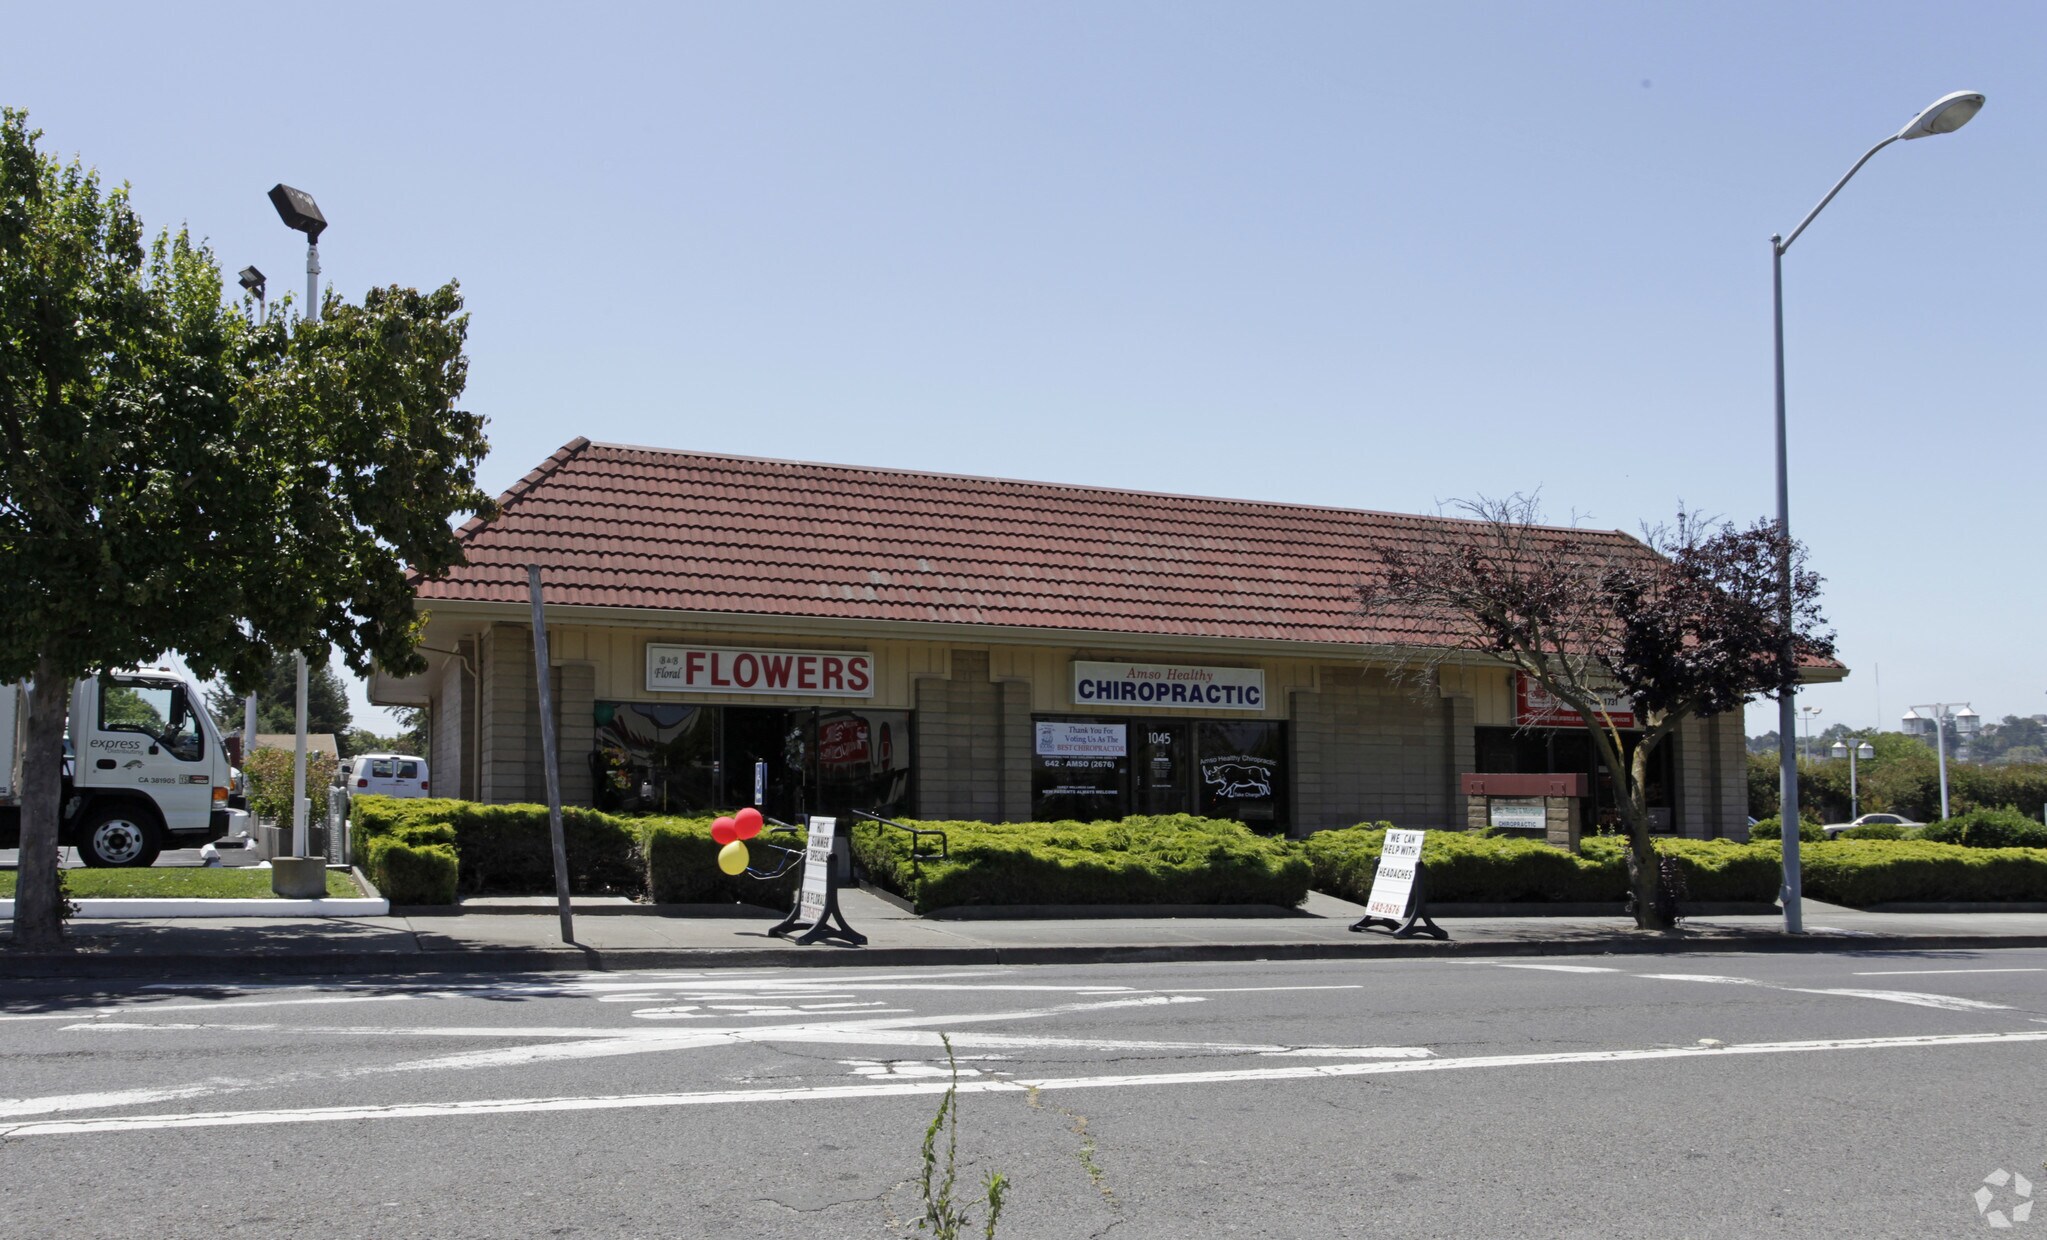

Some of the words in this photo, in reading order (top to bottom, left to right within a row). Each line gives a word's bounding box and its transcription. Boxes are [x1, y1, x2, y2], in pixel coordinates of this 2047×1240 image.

[653, 665, 683, 680] Floral
[685, 651, 870, 692] FLOWERS
[1125, 667, 1161, 681] Amso
[1166, 668, 1214, 683] Healthy
[1078, 678, 1261, 706] CHIROPRACTIC
[1068, 725, 1088, 735] Thank
[1090, 726, 1102, 735] You
[1103, 726, 1114, 735] For
[1065, 734, 1087, 745] Voting
[1087, 735, 1098, 743] Us
[1099, 736, 1107, 744] As
[1107, 736, 1119, 744] The
[1148, 731, 1171, 745] 1045
[90, 738, 140, 752] express
[1056, 744, 1073, 752] BEST
[1073, 744, 1126, 753] CHIROPRACTOR
[1044, 760, 1060, 768] 642
[1065, 760, 1089, 769] AMSO
[1090, 760, 1115, 770] (2676)
[1218, 754, 1241, 762] Healthy
[1241, 754, 1278, 767] Chiropractic
[138, 776, 149, 784] CA
[150, 777, 176, 785] 381905
[817, 822, 826, 834] HOT
[1498, 820, 1537, 829] CHIROPRACTIC
[812, 836, 829, 848] SUMMER
[1391, 834, 1401, 843] WE
[1404, 834, 1416, 844] CAN
[1384, 845, 1400, 854] HELP
[1401, 847, 1417, 856] WITH
[1379, 868, 1412, 879] HEADACHES
